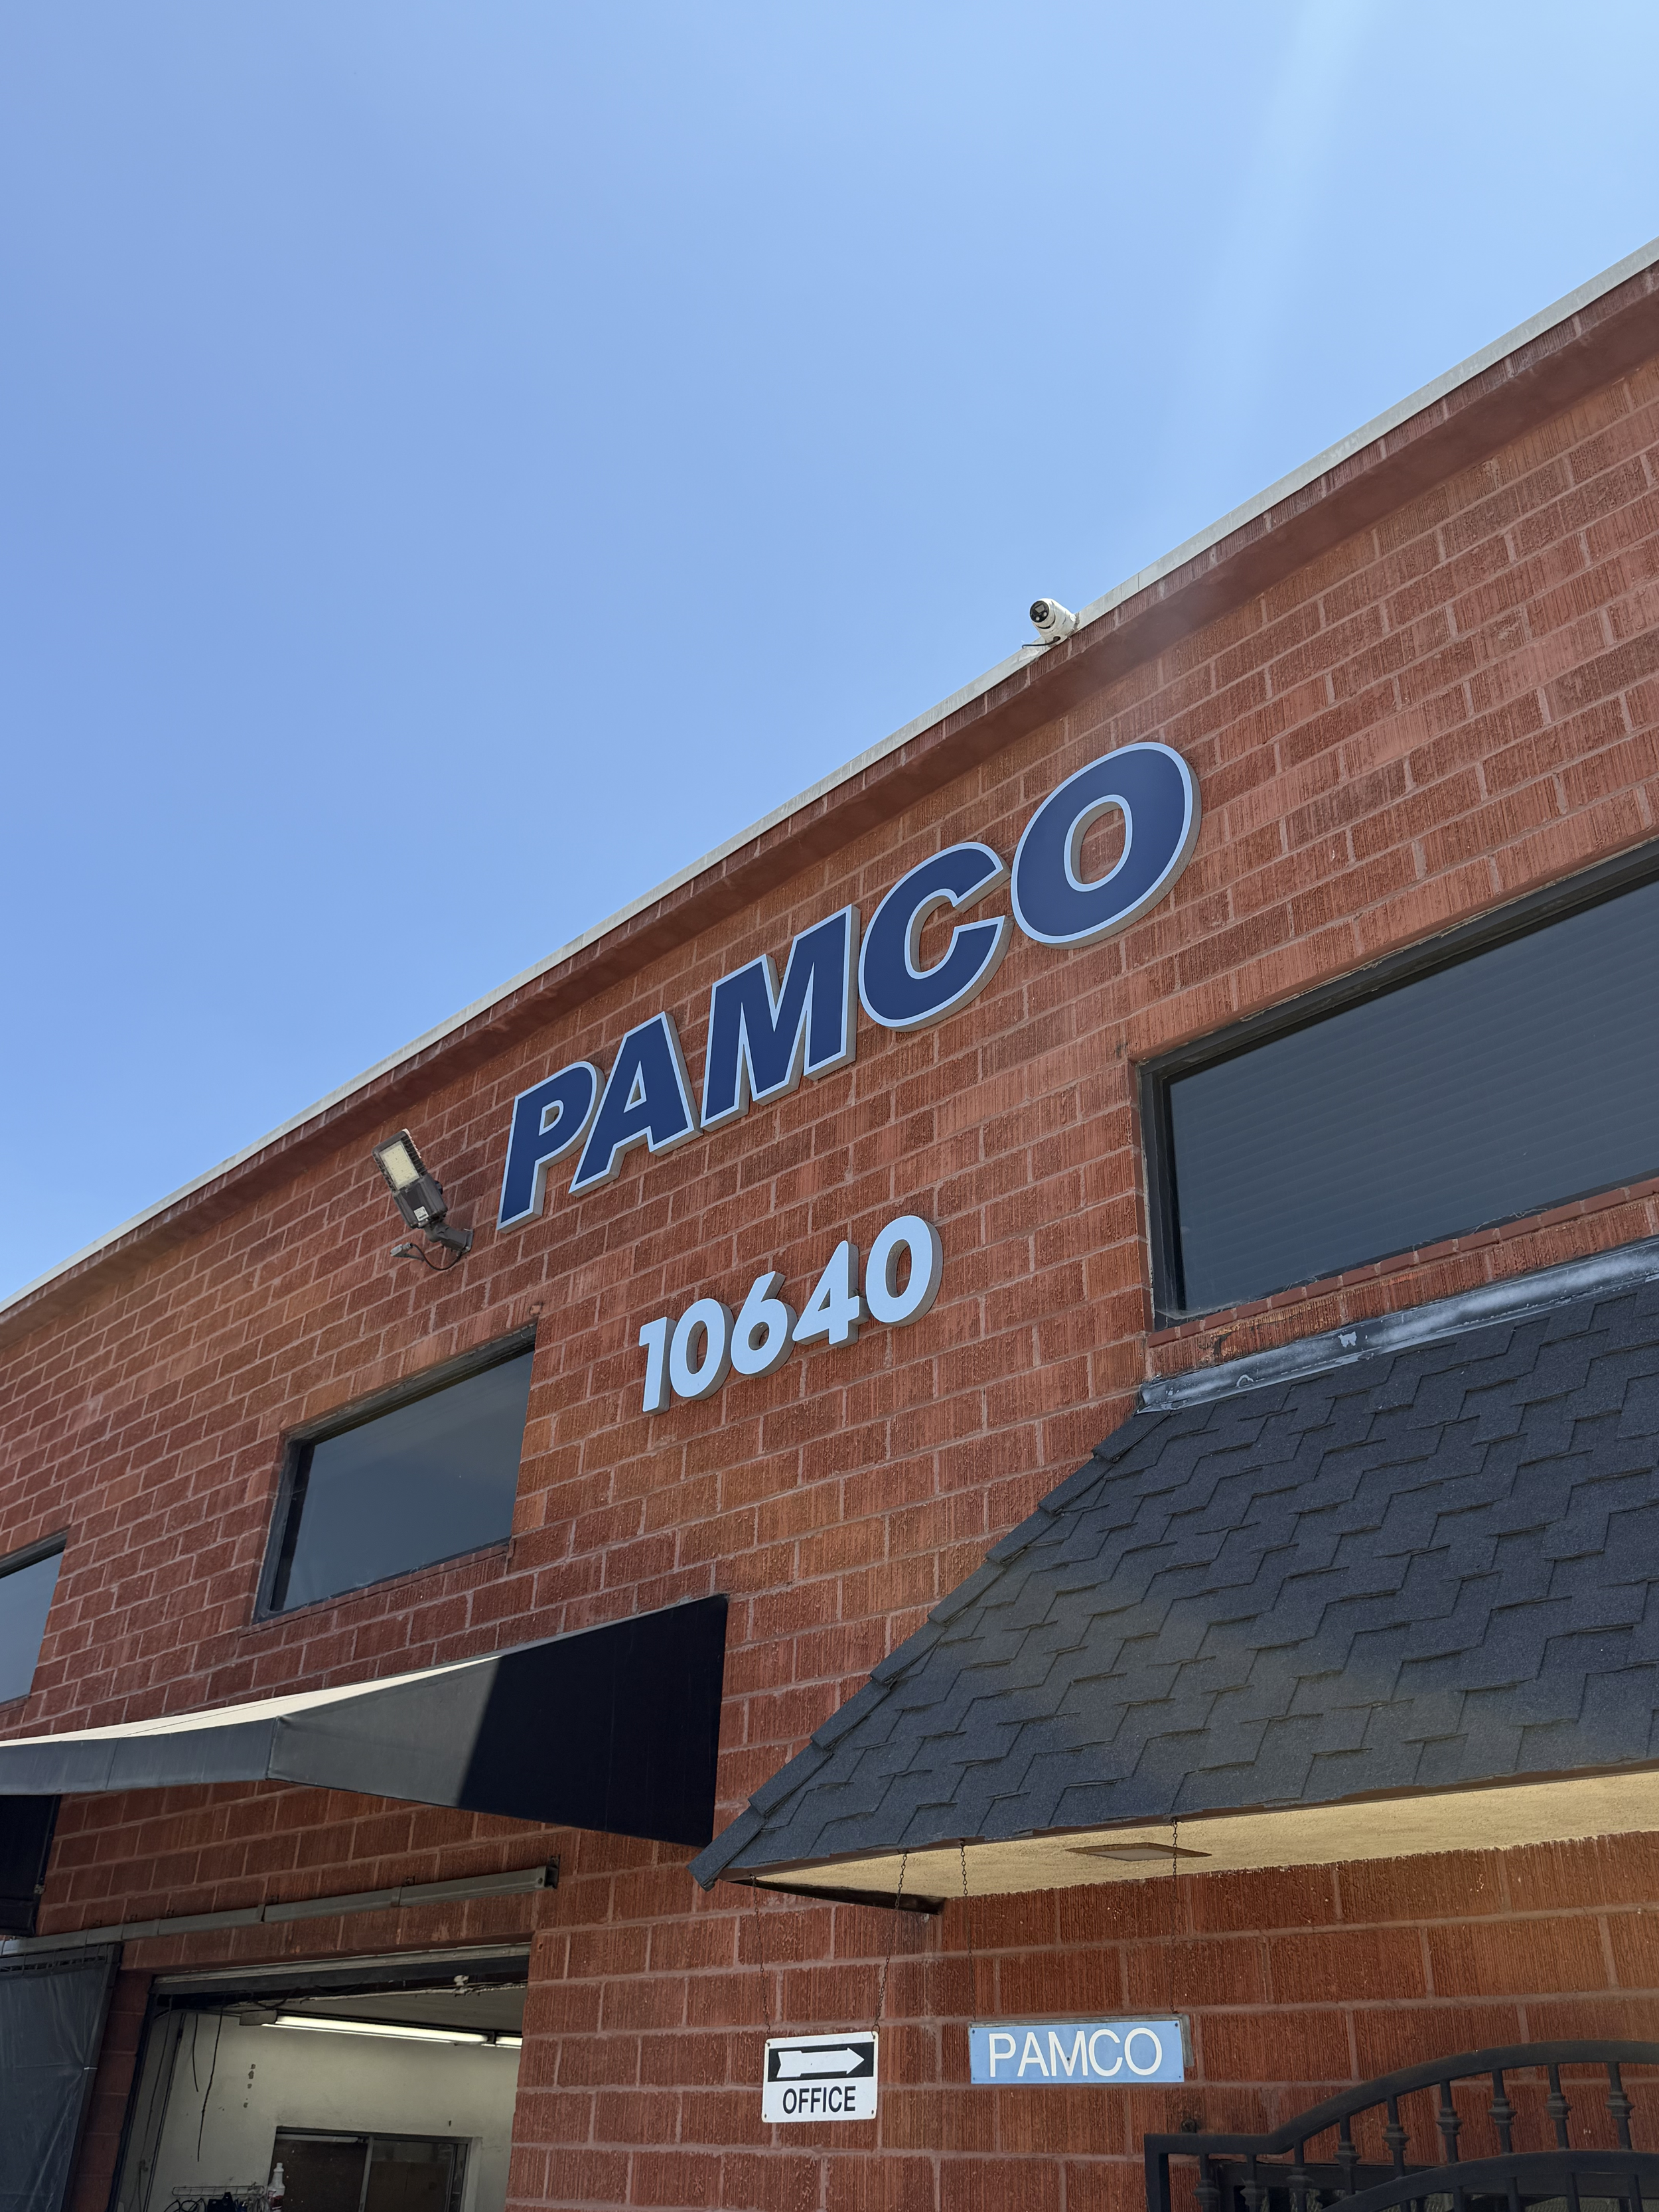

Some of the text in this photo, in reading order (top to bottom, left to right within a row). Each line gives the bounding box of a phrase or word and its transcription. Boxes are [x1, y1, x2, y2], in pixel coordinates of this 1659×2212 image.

[497, 741, 1201, 1233] PAMCO
[638, 1215, 942, 1412] 10640
[782, 2085, 857, 2114] OFFICE
[989, 2028, 1163, 2077] PAMCO
